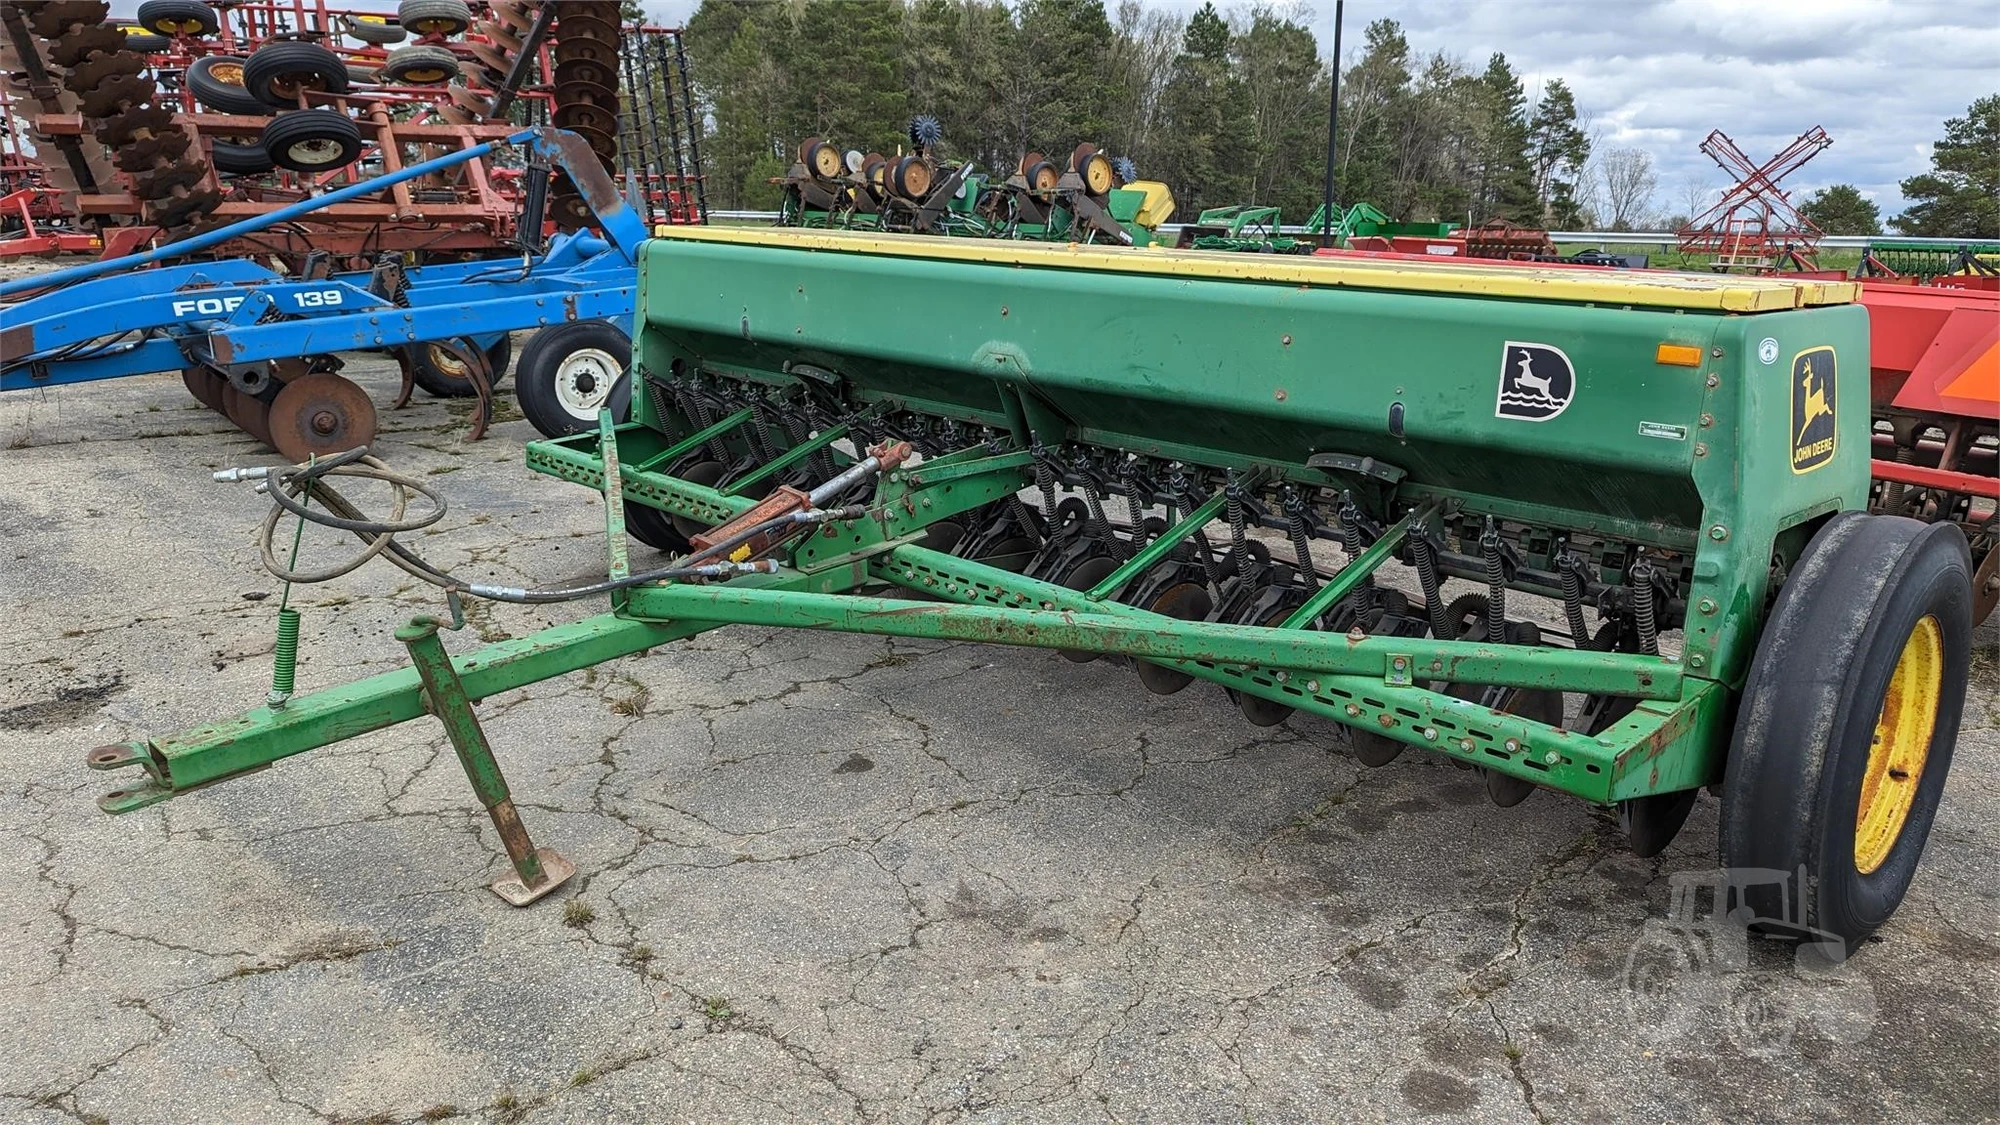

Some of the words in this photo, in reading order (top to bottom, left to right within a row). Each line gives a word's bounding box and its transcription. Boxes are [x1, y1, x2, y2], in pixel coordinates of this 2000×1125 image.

[172, 294, 274, 317] FOR
[293, 290, 343, 307] 139
[1794, 445, 1812, 463] JOHN
[1812, 437, 1833, 456] DEERE
